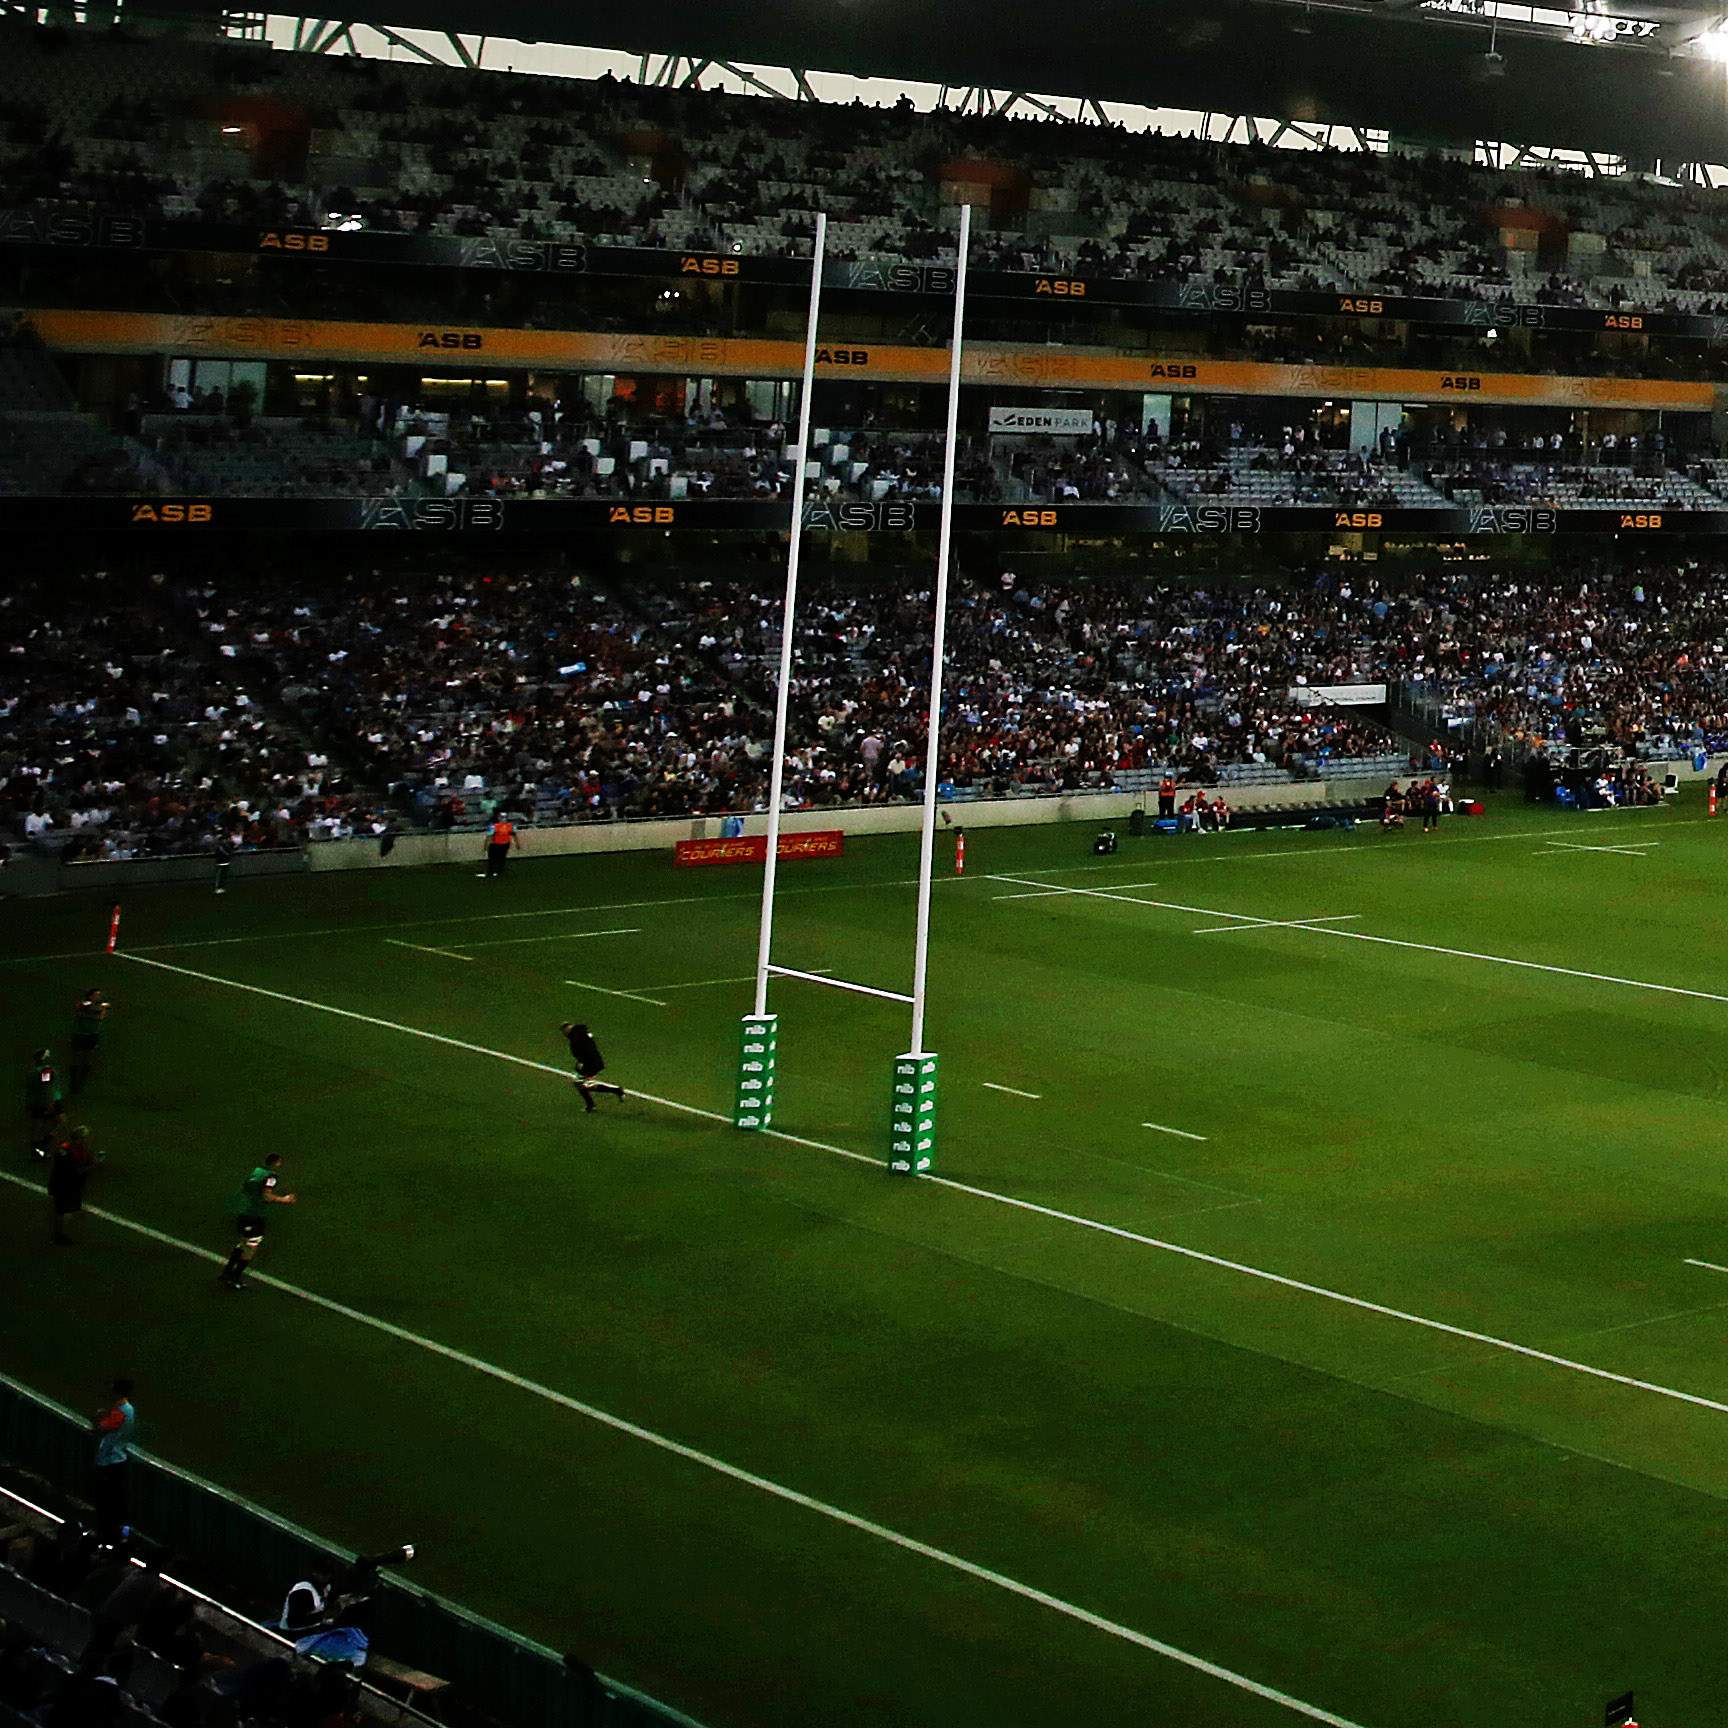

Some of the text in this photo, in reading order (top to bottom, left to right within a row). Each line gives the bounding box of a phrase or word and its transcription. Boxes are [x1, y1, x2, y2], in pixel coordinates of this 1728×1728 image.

[259, 232, 330, 251] ASB
[681, 257, 739, 275] ASB
[1035, 279, 1086, 297] ASB
[1339, 298, 1384, 314] ASB
[1604, 314, 1643, 330] ASB
[418, 332, 482, 350] ASB
[813, 350, 868, 365] ASB
[1150, 364, 1197, 379] ASB
[1441, 376, 1481, 391] ASB
[1018, 416, 1088, 427] EDEN PARK
[131, 504, 212, 523] ASB
[609, 507, 675, 524] ASB
[1001, 510, 1058, 526] ASB
[1335, 512, 1383, 529] ASB
[1621, 514, 1662, 530] ASB
